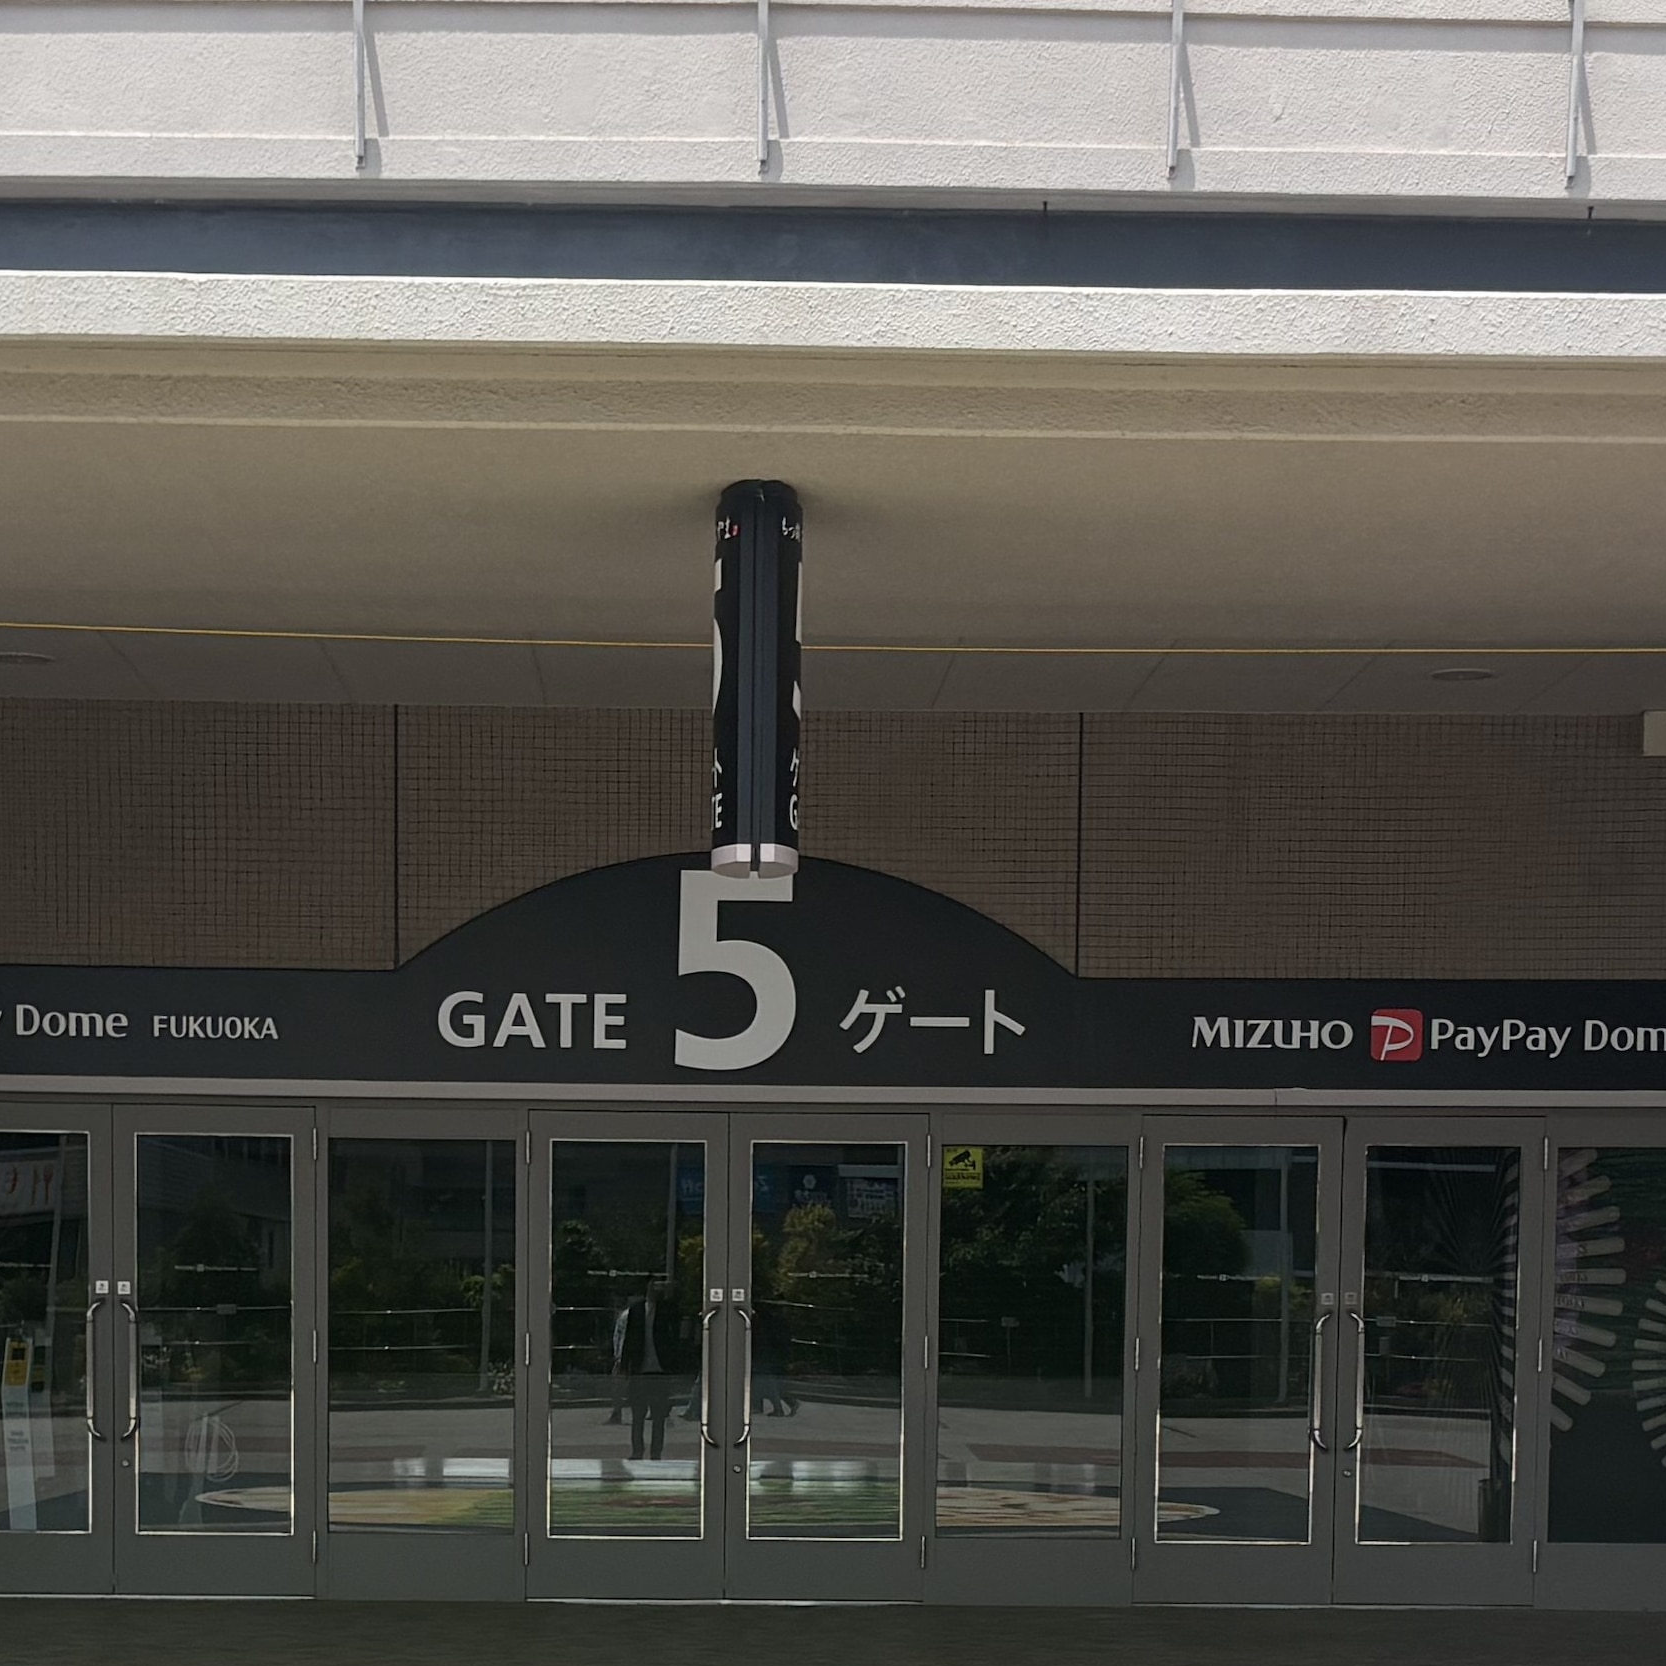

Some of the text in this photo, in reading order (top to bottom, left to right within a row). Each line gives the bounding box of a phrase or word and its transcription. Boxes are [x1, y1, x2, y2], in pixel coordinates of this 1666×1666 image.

[437, 869, 1026, 1070] GATE 5 ゲート
[16, 1004, 129, 1038] Dome
[153, 1015, 279, 1040] FUKUOKA
[1191, 1016, 1354, 1050] MIZUHO
[1430, 1018, 1572, 1058] PayPay
